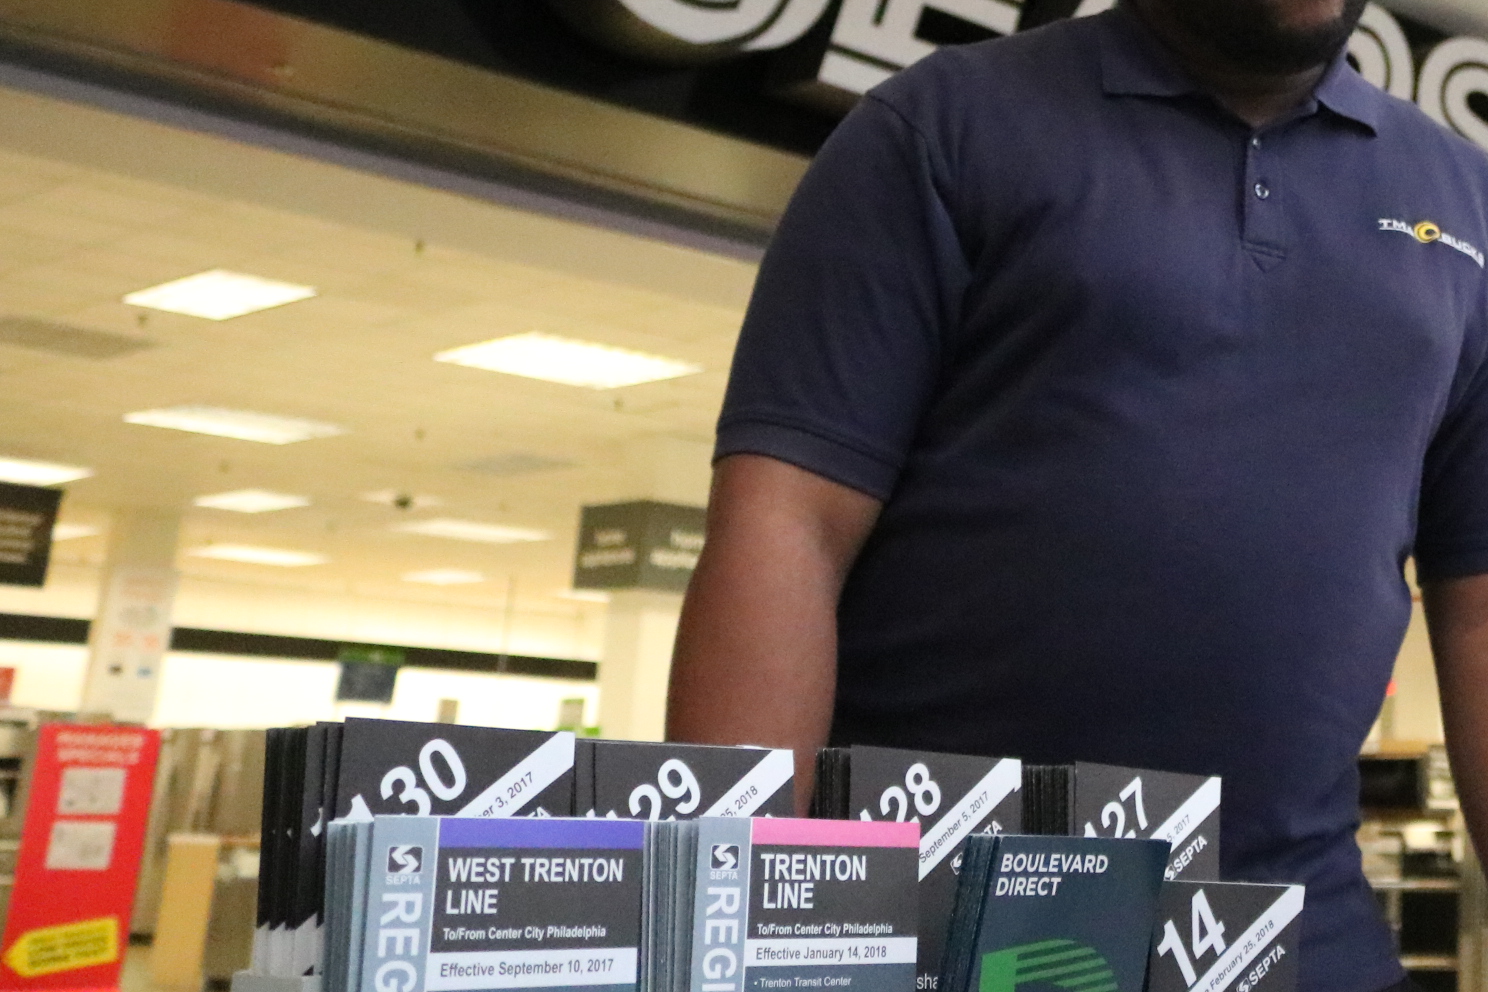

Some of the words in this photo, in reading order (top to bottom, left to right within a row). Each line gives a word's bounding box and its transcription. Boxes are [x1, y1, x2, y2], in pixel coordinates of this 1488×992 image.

[495, 796, 508, 809] 3,
[506, 771, 533, 799] 2017
[734, 785, 758, 810] 2018
[919, 819, 962, 863] September
[961, 811, 972, 822] 5,
[969, 791, 989, 813] 2017
[1173, 814, 1190, 836] 2017
[1000, 854, 1109, 874] BOULEVARD
[1172, 835, 1208, 873] SEPTA
[448, 858, 515, 883] WEST
[520, 858, 624, 883] TRENTON
[709, 871, 738, 880] SEPTA
[761, 853, 867, 881] TRENTON
[385, 875, 420, 885] SEPTA
[995, 877, 1061, 896] DIRECT
[445, 889, 498, 915] LINE
[763, 882, 815, 909] LINE
[443, 927, 486, 941] To/From
[488, 926, 522, 940] Center
[524, 925, 544, 942] City
[547, 925, 606, 941] Philadelphia
[757, 923, 793, 936] To/From
[794, 923, 823, 935] Center
[824, 922, 841, 937] City
[842, 922, 893, 936] Philadelphia
[1156, 888, 1227, 988] 14
[756, 947, 801, 961] Effective
[803, 946, 845, 963] January
[847, 946, 861, 959] 14,
[864, 945, 887, 959] 2018
[1210, 952, 1244, 990] February
[1243, 940, 1257, 955] 25,
[1255, 919, 1275, 943] 2018
[1248, 944, 1286, 985] SEPTA
[440, 962, 495, 978] Effective
[498, 961, 564, 979] September
[568, 960, 584, 975] 10,
[587, 958, 614, 973] 2017
[760, 977, 792, 988] Trenton
[794, 976, 823, 988] Transit
[824, 975, 852, 987] Center
